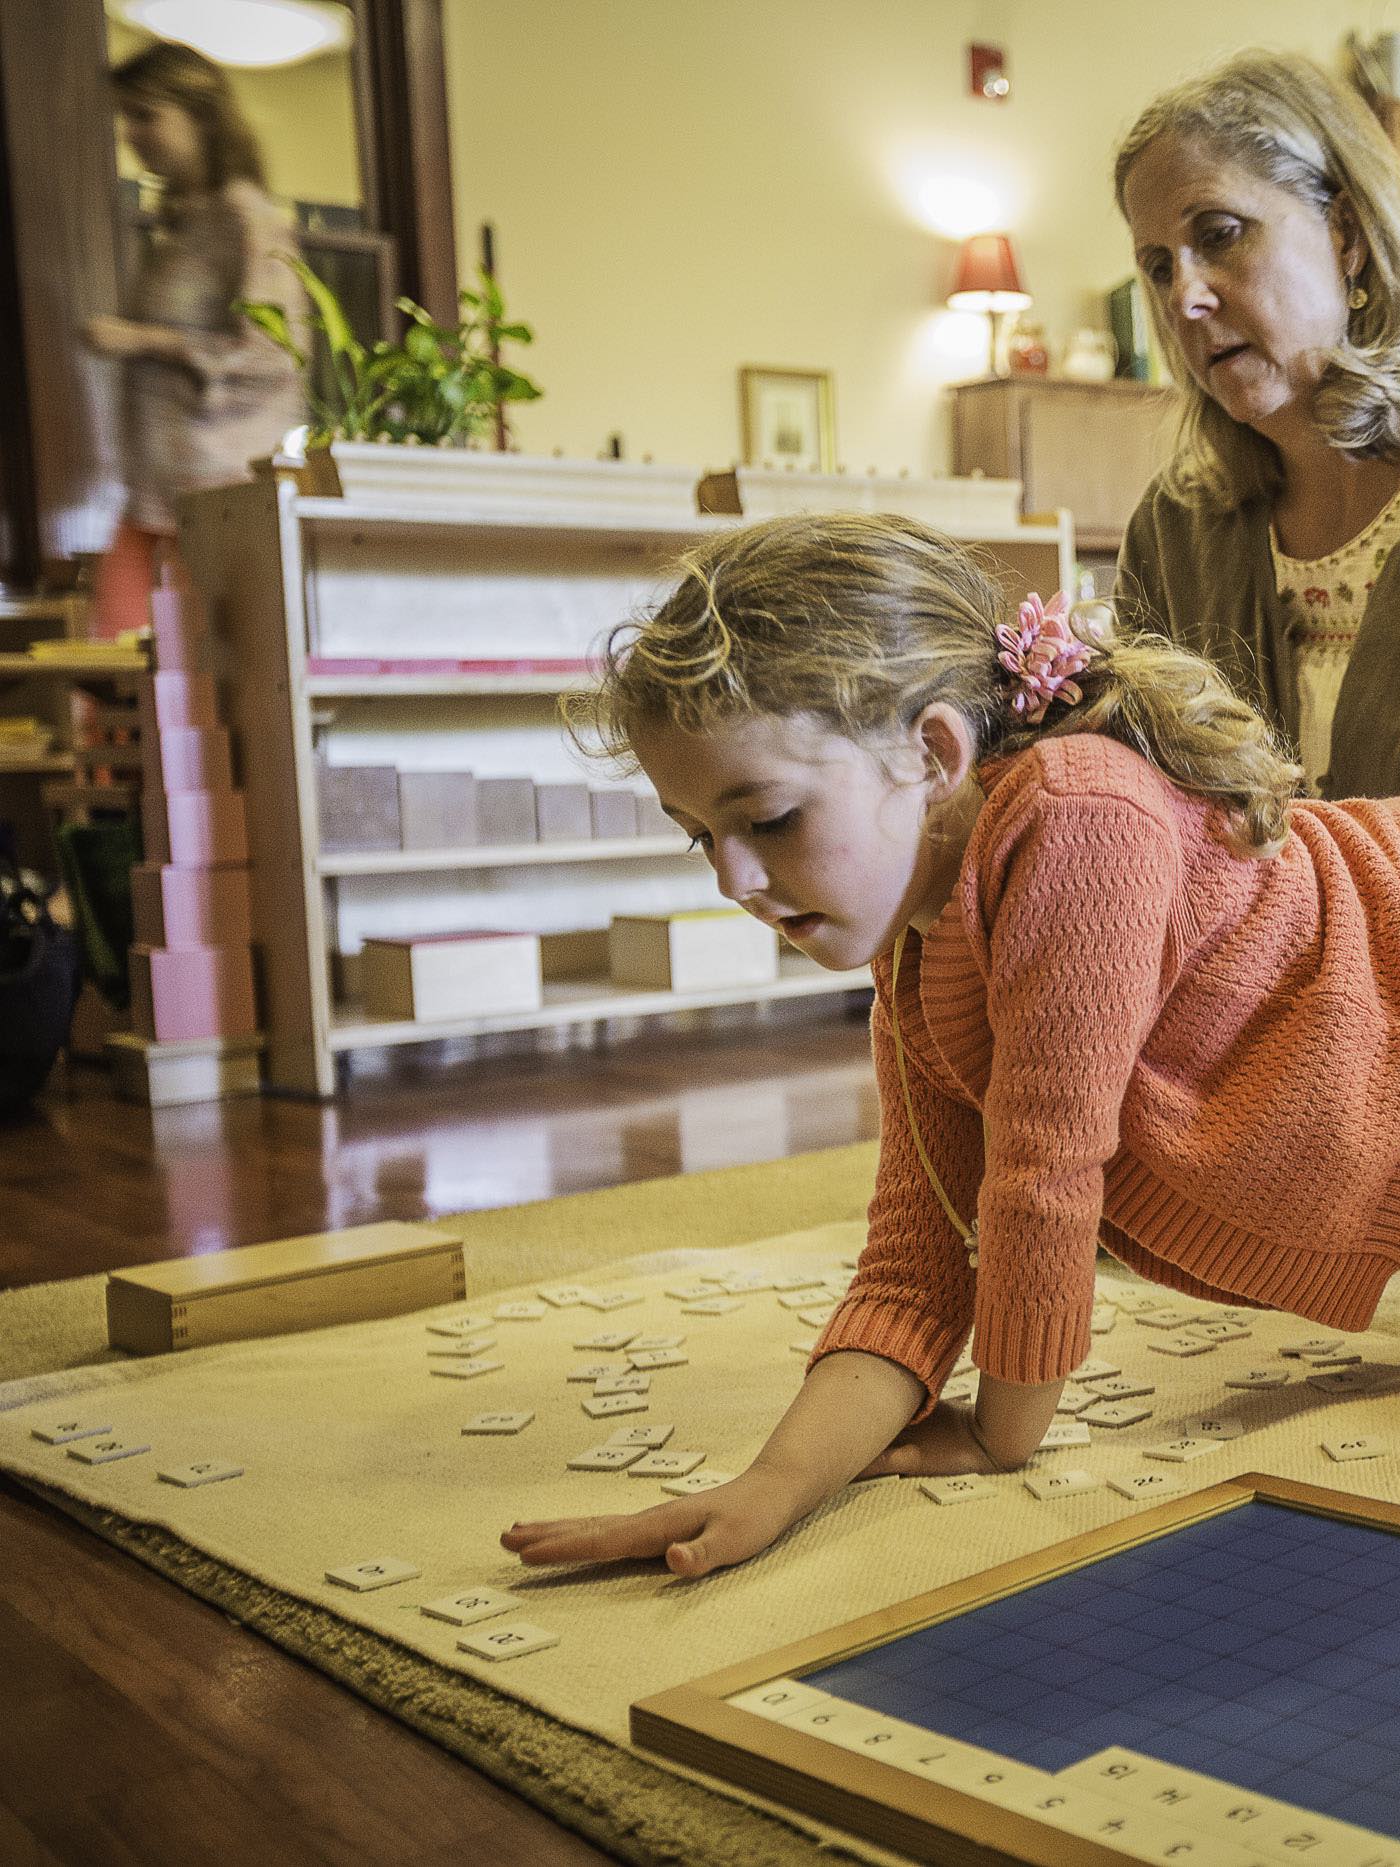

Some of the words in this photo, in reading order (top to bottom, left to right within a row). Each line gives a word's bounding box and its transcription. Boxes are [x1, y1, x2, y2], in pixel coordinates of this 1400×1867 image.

[488, 1632, 526, 1646] 20
[812, 1712, 838, 1725] 9
[863, 1733, 893, 1746] 8
[917, 1752, 947, 1767] 7
[980, 1772, 1004, 1786] 6
[1100, 1763, 1139, 1781] 15
[1036, 1796, 1066, 1811] 5
[1225, 1806, 1262, 1823] 13
[1097, 1818, 1127, 1835] 4
[1163, 1841, 1194, 1858] 3
[1282, 1832, 1323, 1852] 12
